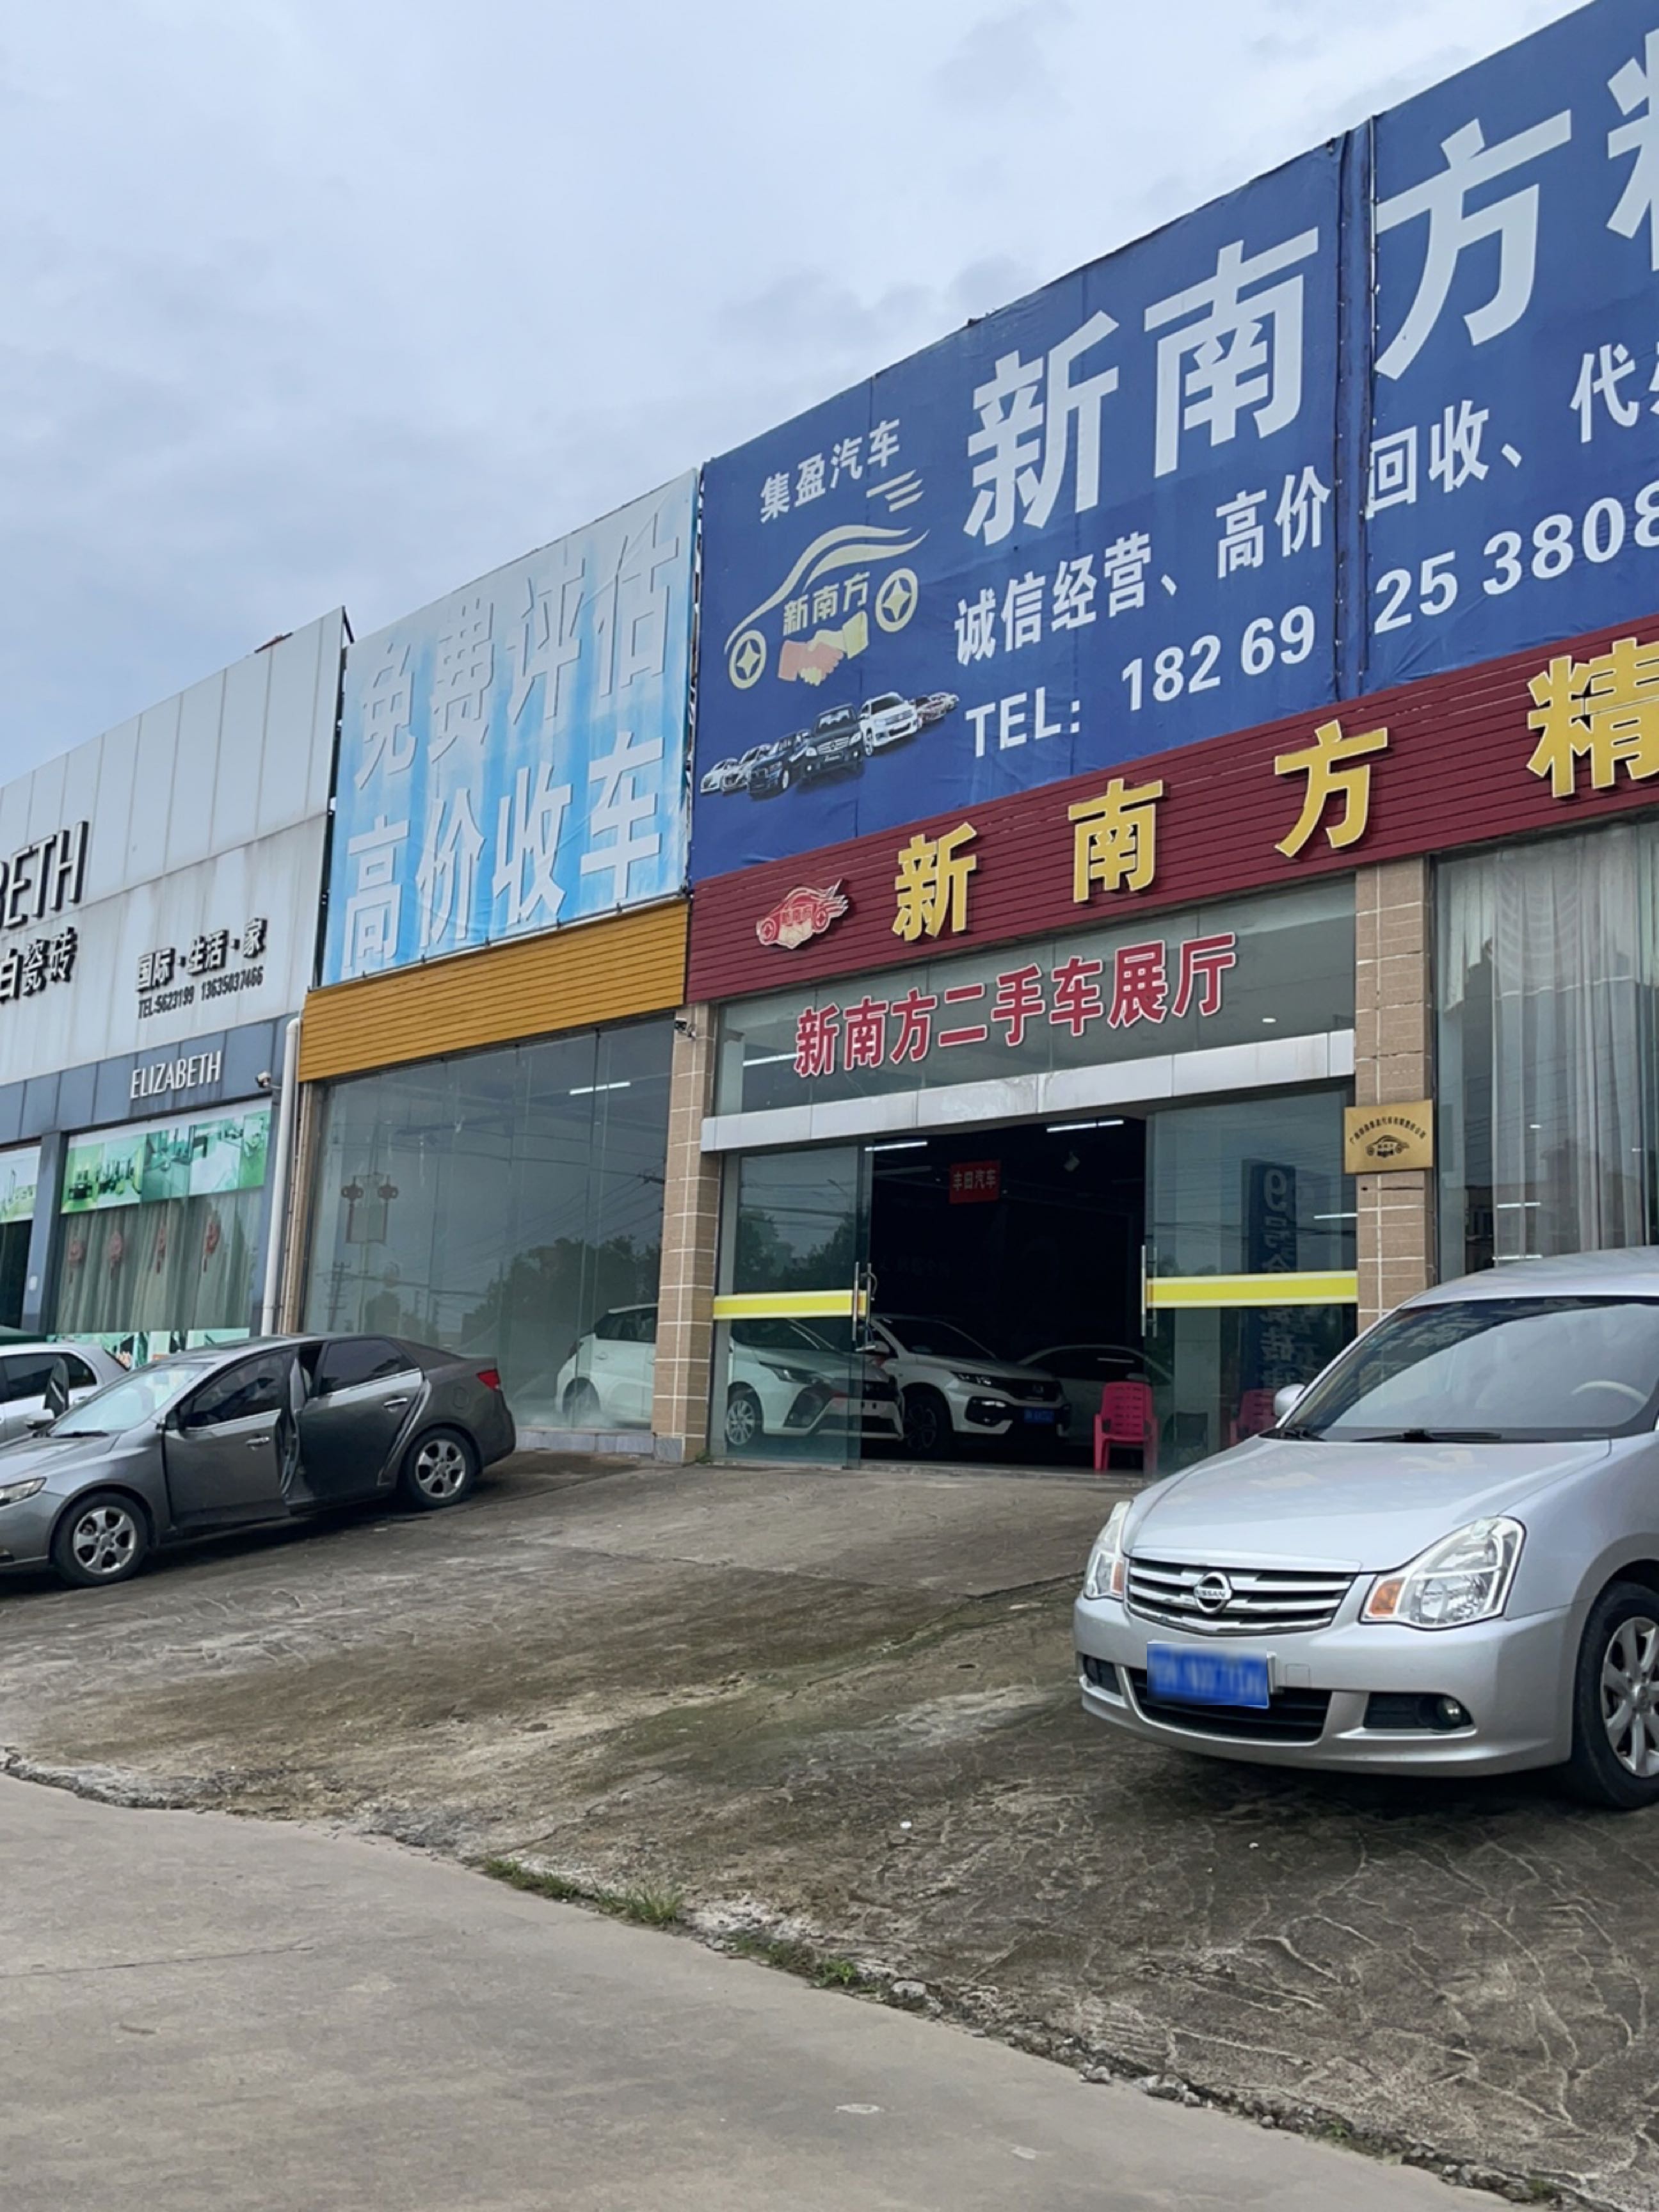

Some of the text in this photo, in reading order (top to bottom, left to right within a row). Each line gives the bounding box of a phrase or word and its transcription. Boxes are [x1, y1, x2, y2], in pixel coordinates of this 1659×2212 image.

[760, 419, 900, 523] 集盈汽车
[954, 342, 1659, 667] 诚信经营、高价回收、代
[354, 513, 678, 790] 免费评估
[783, 571, 870, 636] 新南方
[966, 686, 1080, 757] TEL:
[1122, 636, 1221, 711] 182
[1242, 605, 1315, 676] 69
[1375, 551, 1457, 634] 25
[342, 731, 664, 978] 高价收车
[892, 637, 1659, 942] 新南方精
[130, 1050, 221, 1099] ELIZABETH
[794, 933, 1236, 1077] 新南方二手车展厅
